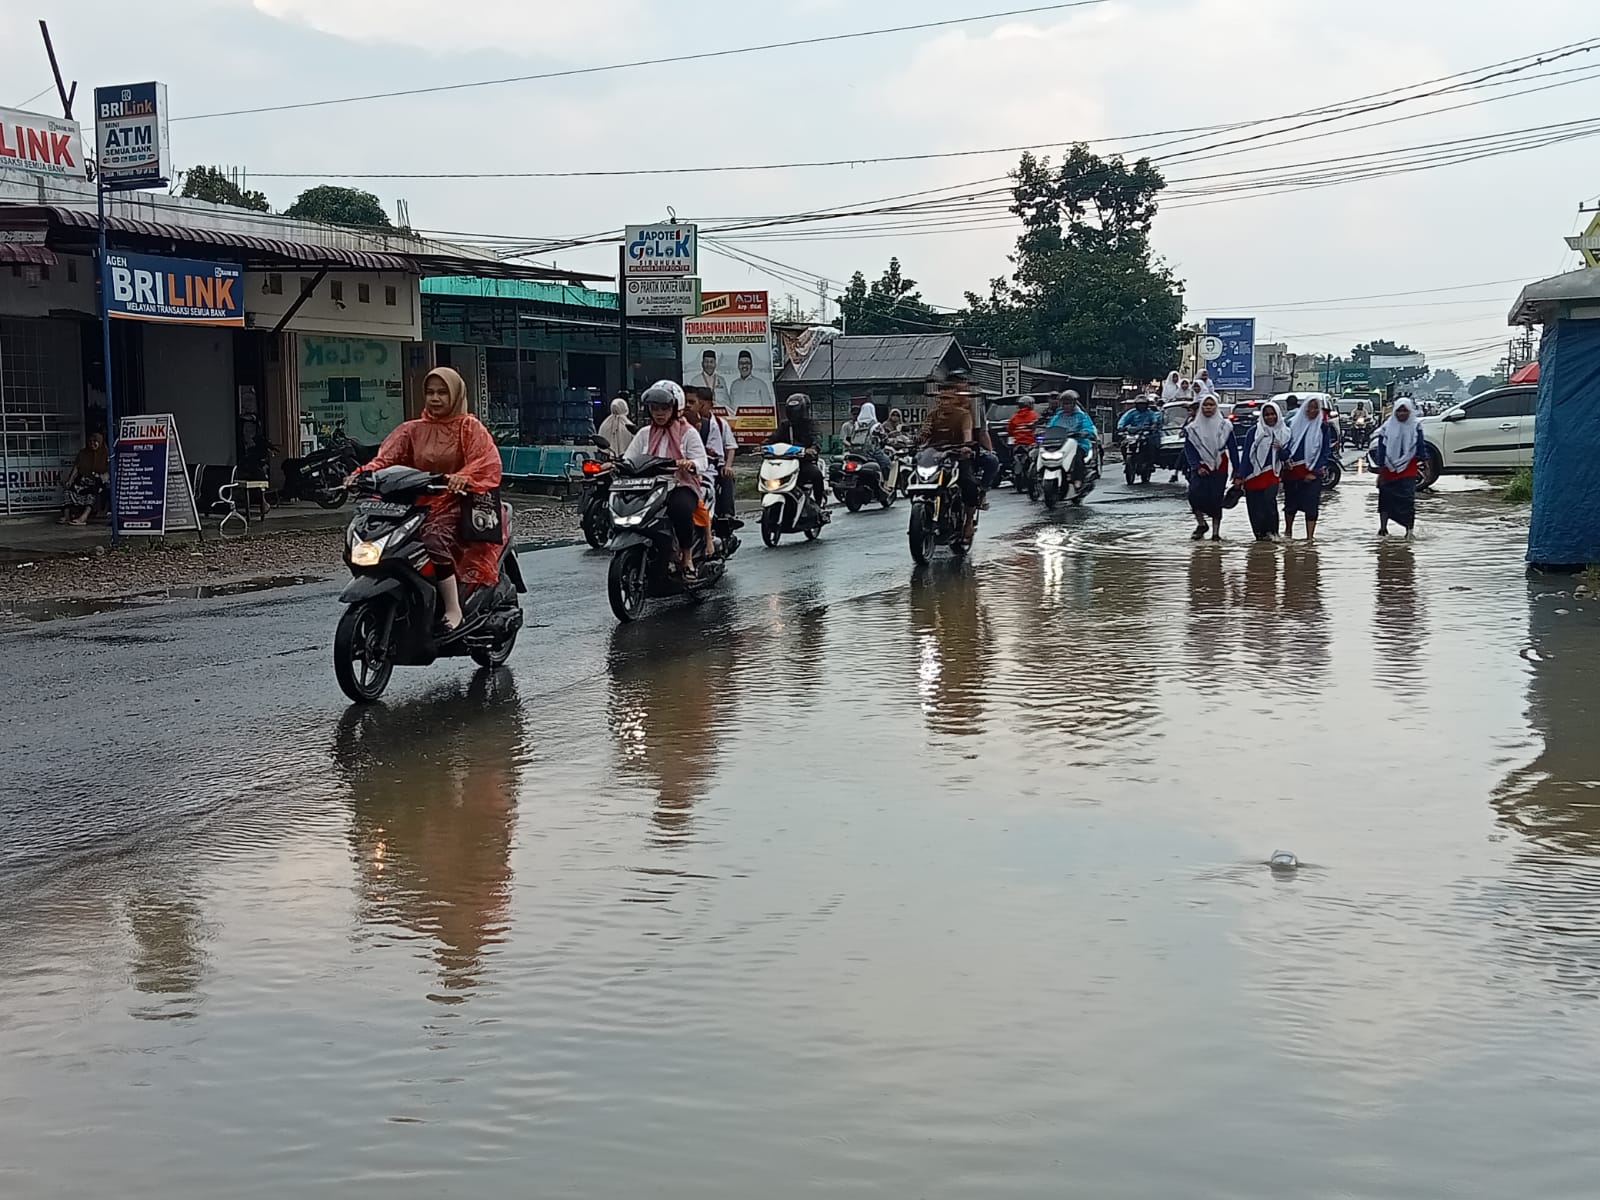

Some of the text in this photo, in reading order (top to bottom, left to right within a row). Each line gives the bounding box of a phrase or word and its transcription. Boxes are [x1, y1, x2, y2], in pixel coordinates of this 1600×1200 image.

[100, 99, 153, 118] BRILink
[105, 125, 152, 148] ATM
[106, 255, 127, 267] AGEN
[126, 302, 226, 317] MELAYANI TRANSAKSI SEMUA BANK
[1005, 370, 1017, 395] FOTO
[121, 425, 166, 438] BRILINK
